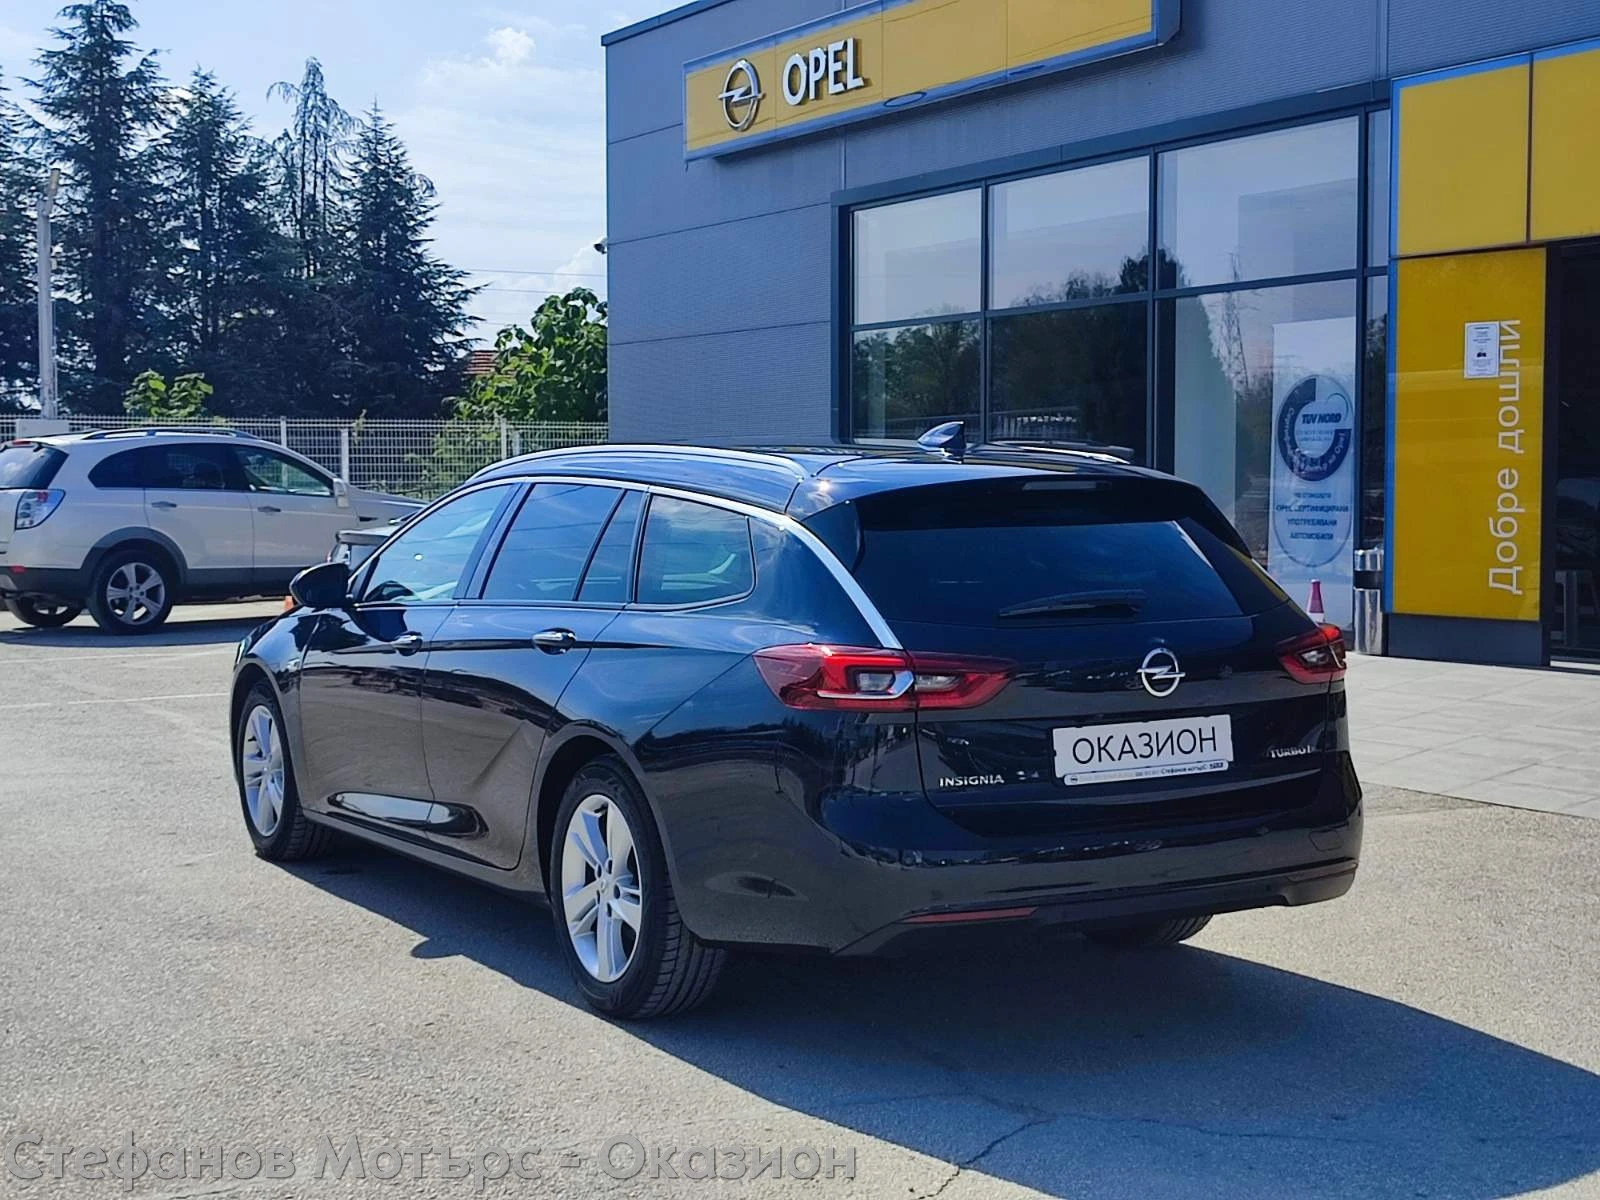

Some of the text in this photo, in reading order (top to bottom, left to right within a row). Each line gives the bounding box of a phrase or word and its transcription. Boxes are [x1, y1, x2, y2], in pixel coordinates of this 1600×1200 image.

[782, 37, 865, 106] OPEL
[1317, 413, 1342, 424] NORD
[1488, 319, 1525, 595] Добре дошли
[1072, 726, 1217, 765] ОКАЗИОН
[940, 775, 1004, 787] INSIGNIA
